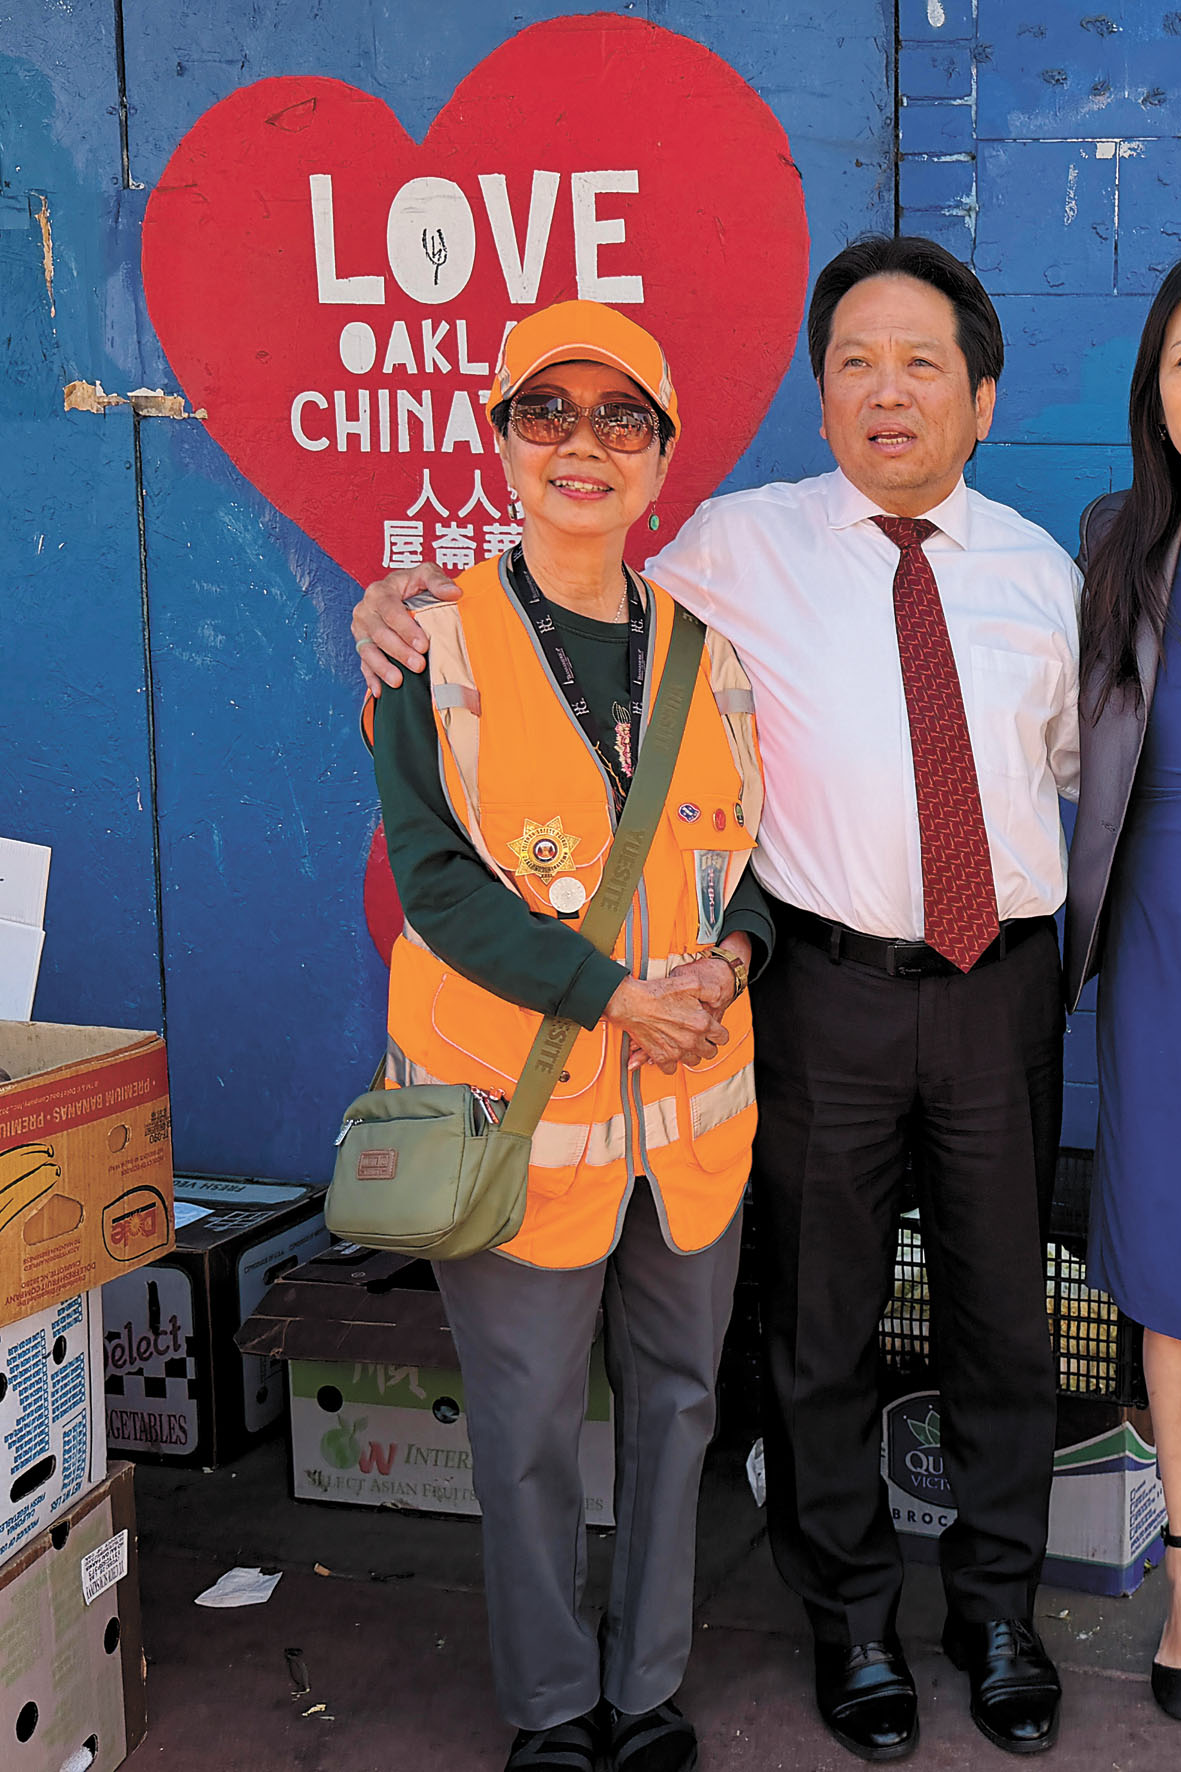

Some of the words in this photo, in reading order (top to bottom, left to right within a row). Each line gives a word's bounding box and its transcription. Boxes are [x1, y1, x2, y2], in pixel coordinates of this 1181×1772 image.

[309, 170, 645, 305] LOVE
[105, 1078, 150, 1106] PREMIUM
[52, 1093, 102, 1122] BANANAS
[200, 1182, 246, 1193] FRESH
[111, 1208, 157, 1248] Dole
[4, 1283, 40, 1306] COMPANY
[404, 1443, 473, 1470] INTER
[370, 1478, 417, 1497] ASIAN
[892, 1508, 949, 1527] BROC
